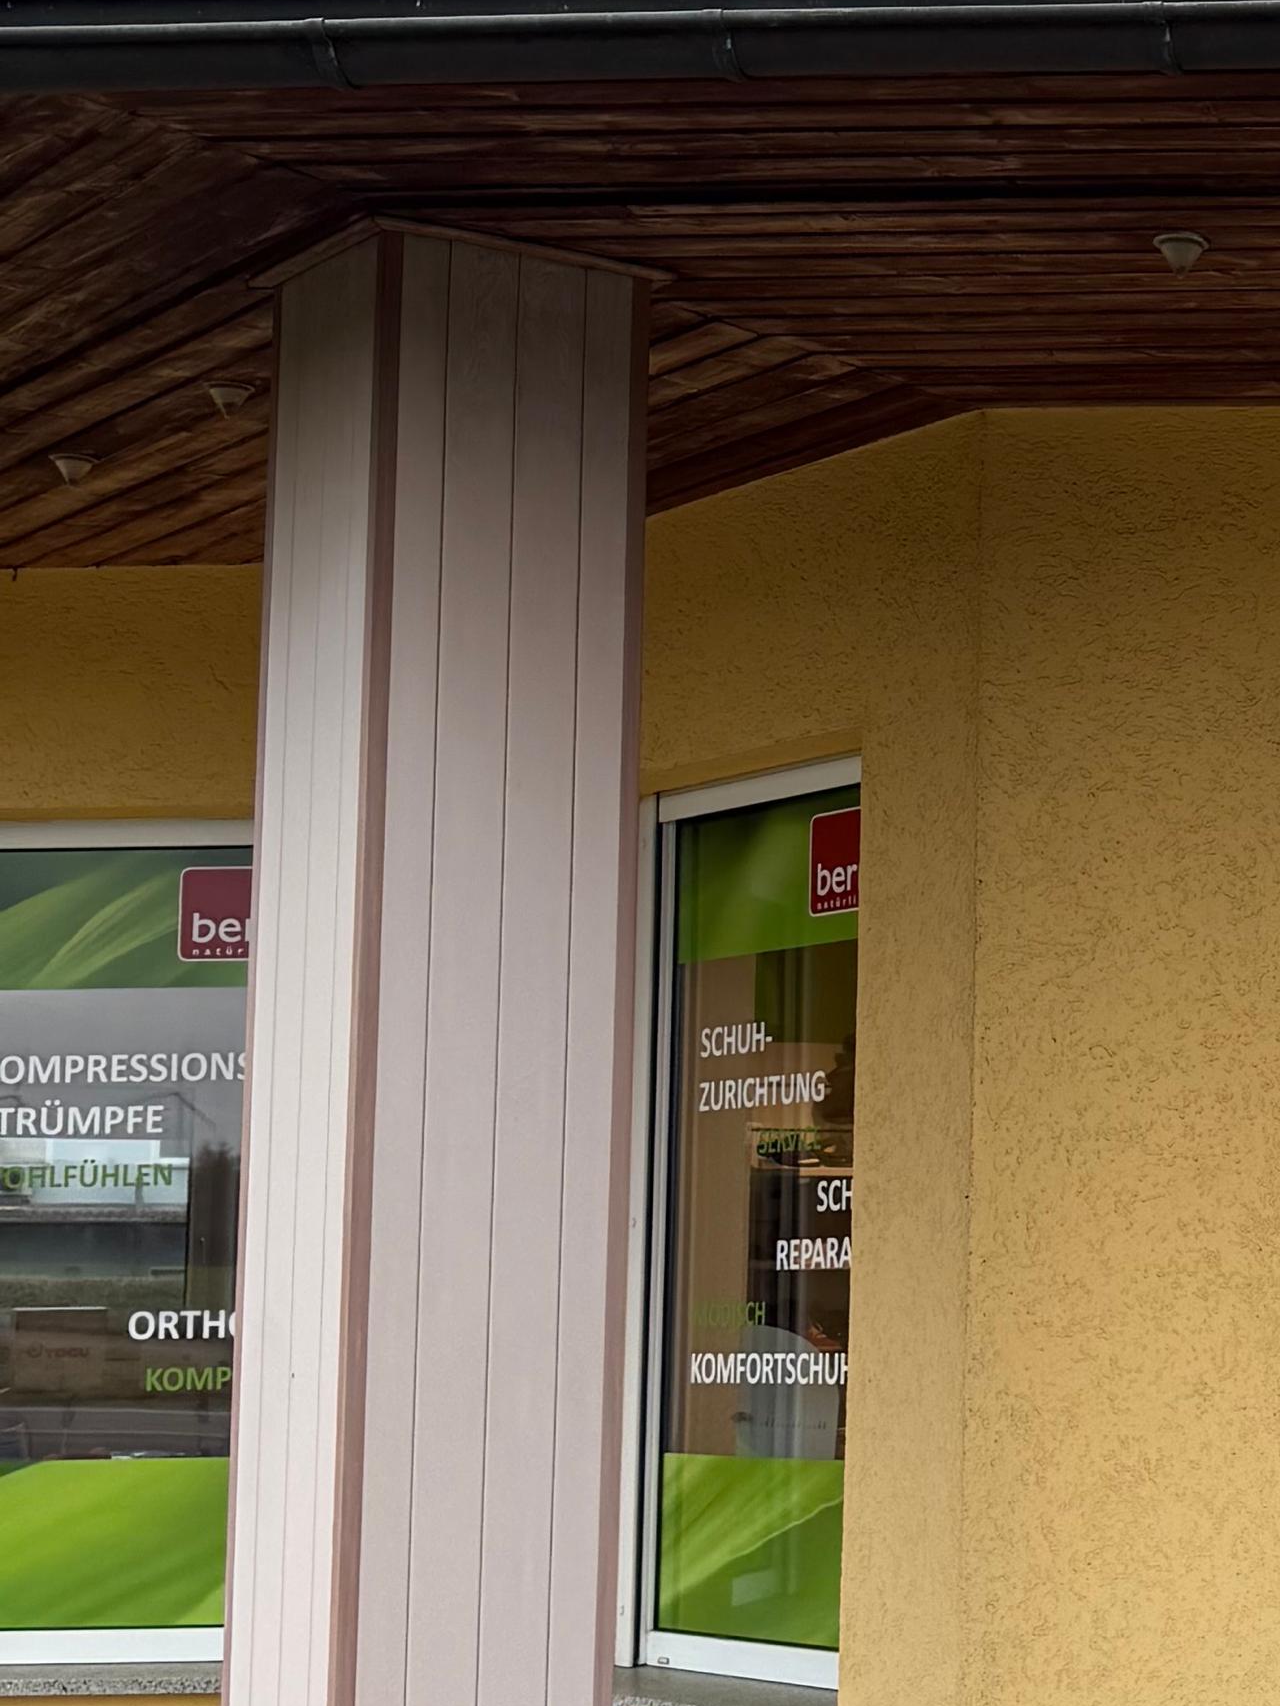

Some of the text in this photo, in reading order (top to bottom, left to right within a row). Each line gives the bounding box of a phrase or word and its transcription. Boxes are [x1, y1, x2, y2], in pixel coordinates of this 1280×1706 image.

[816, 863, 858, 897] ber
[700, 1021, 773, 1058] SCHUH-
[698, 1069, 827, 1113] ZURICHTUNG
[128, 1309, 236, 1341] ORTH
